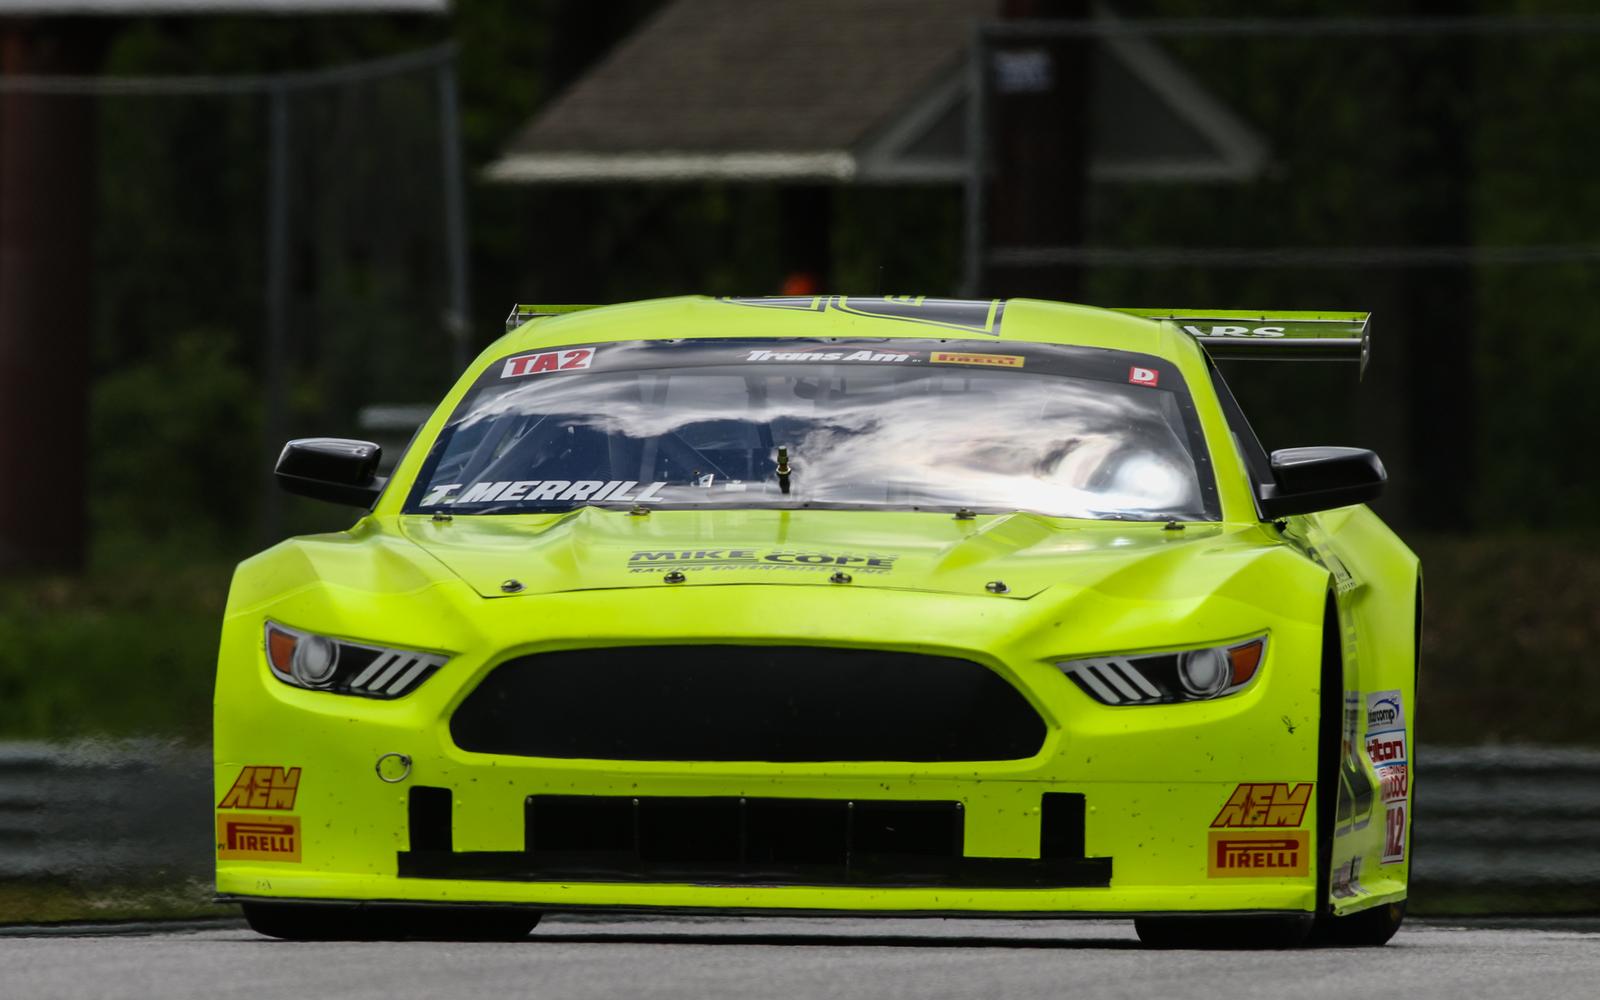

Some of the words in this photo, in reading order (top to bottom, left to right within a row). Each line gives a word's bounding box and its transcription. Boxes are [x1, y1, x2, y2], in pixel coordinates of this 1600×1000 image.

[510, 349, 592, 376] TA2
[747, 350, 844, 361] Trans
[843, 350, 909, 362] Am
[938, 353, 1018, 366] PIRELLI
[1133, 367, 1155, 381] D
[457, 480, 667, 503] MERRILL
[629, 549, 758, 561] MIKE
[764, 554, 895, 567] COPE
[217, 766, 301, 810] AEM
[1209, 783, 1313, 828] AEM
[226, 822, 295, 853] PIRELLI
[1216, 840, 1299, 868] PIRELLI
